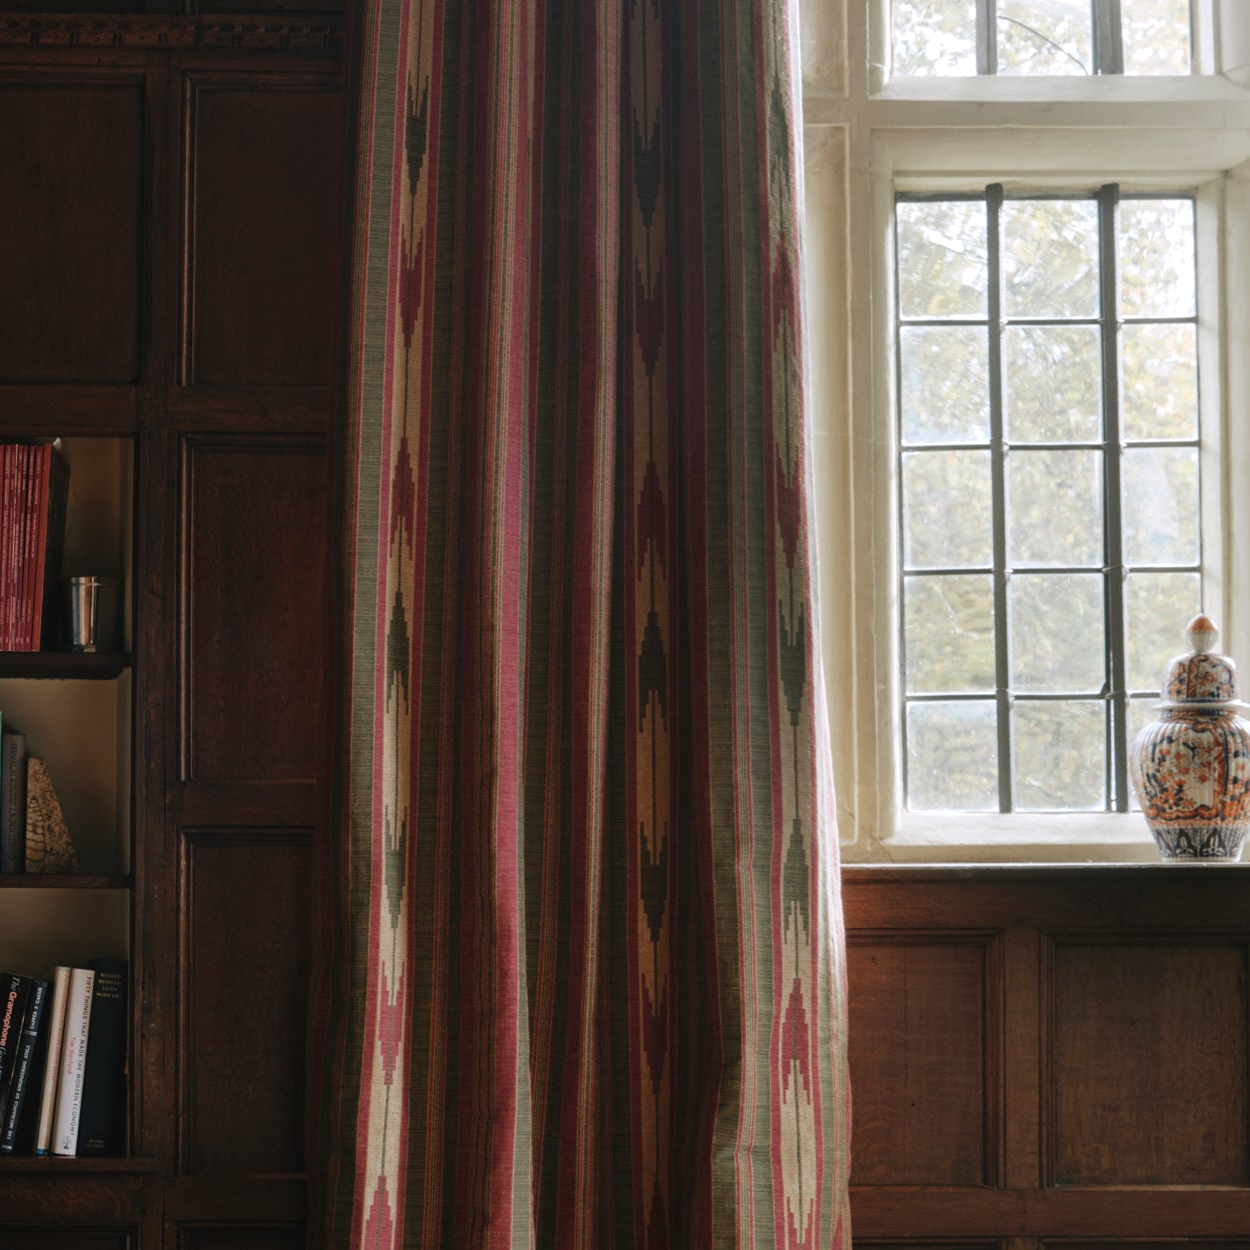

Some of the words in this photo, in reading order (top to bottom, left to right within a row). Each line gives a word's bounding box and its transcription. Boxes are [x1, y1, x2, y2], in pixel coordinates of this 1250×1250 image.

[10, 976, 21, 991] The
[0, 991, 18, 1046] Gramophone
[82, 996, 90, 1020] THINGS
[80, 1022, 88, 1037] THAT
[78, 1040, 86, 1057] MADE
[16, 1060, 28, 1092] ENGINEERING
[76, 1060, 84, 1071] THE
[73, 1073, 82, 1101] MODERN
[8, 1101, 20, 1129] MECHANICS
[69, 1103, 78, 1136] ECONOMY
[6, 1130, 14, 1140] THE
